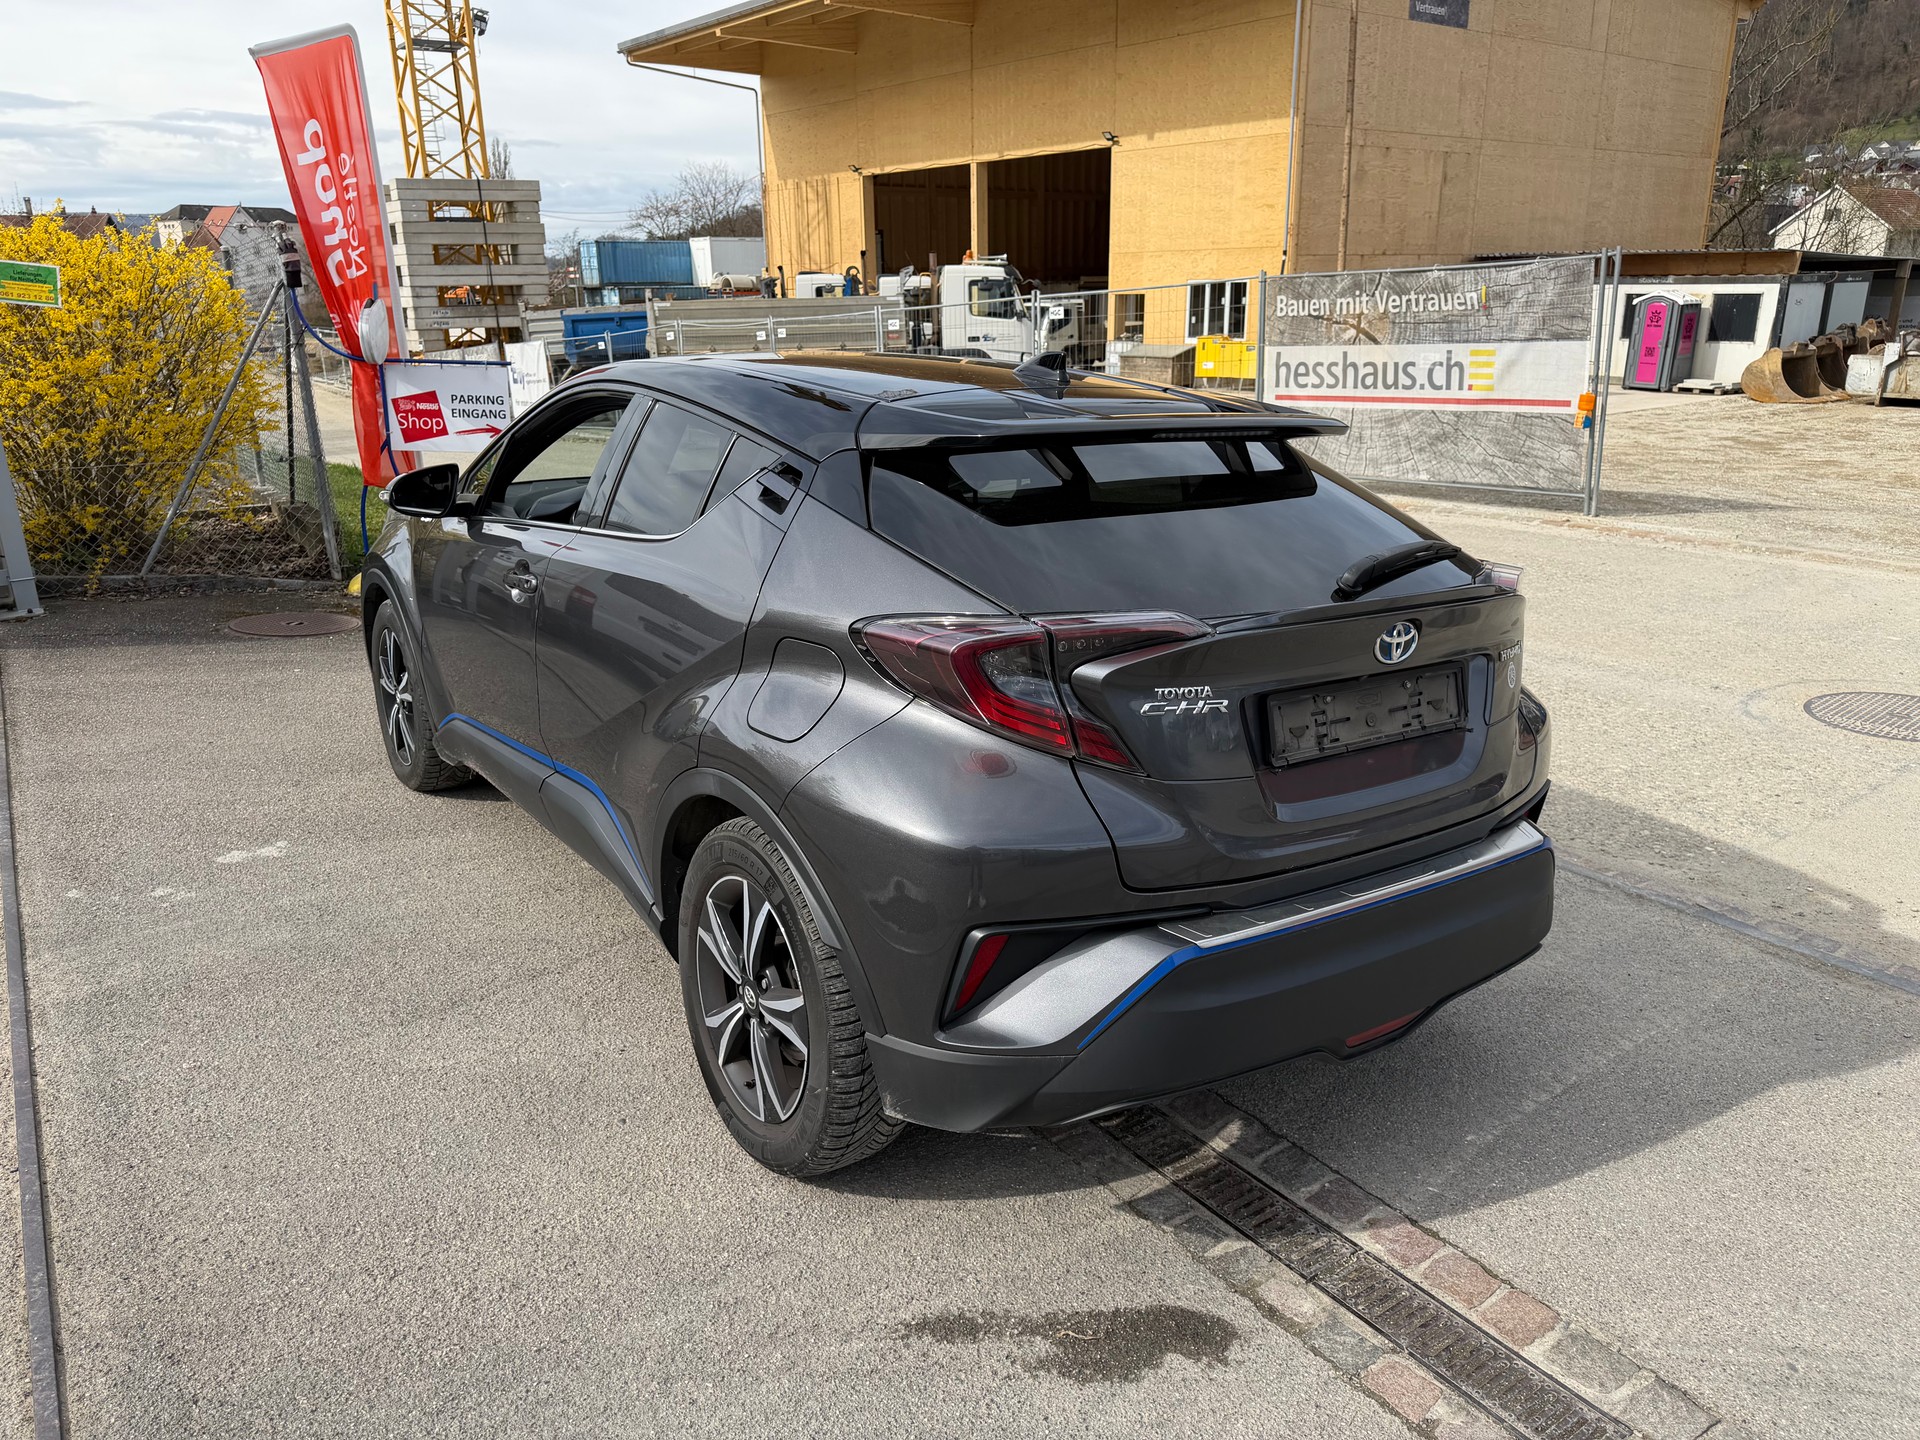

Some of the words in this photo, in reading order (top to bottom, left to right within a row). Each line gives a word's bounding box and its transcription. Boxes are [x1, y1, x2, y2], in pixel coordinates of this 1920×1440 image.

[1275, 294, 1331, 317] Bauen
[1336, 290, 1370, 315] mit
[1374, 284, 1488, 314] Vertrauen!
[1274, 350, 1465, 391] hesshaus.ch
[450, 394, 505, 406] PARKING
[397, 412, 444, 434] Shop
[451, 408, 507, 420] EINGANG
[1154, 685, 1213, 700] TOYOTA
[1140, 699, 1229, 717] C-HR
[784, 912, 806, 959] ROTATION
